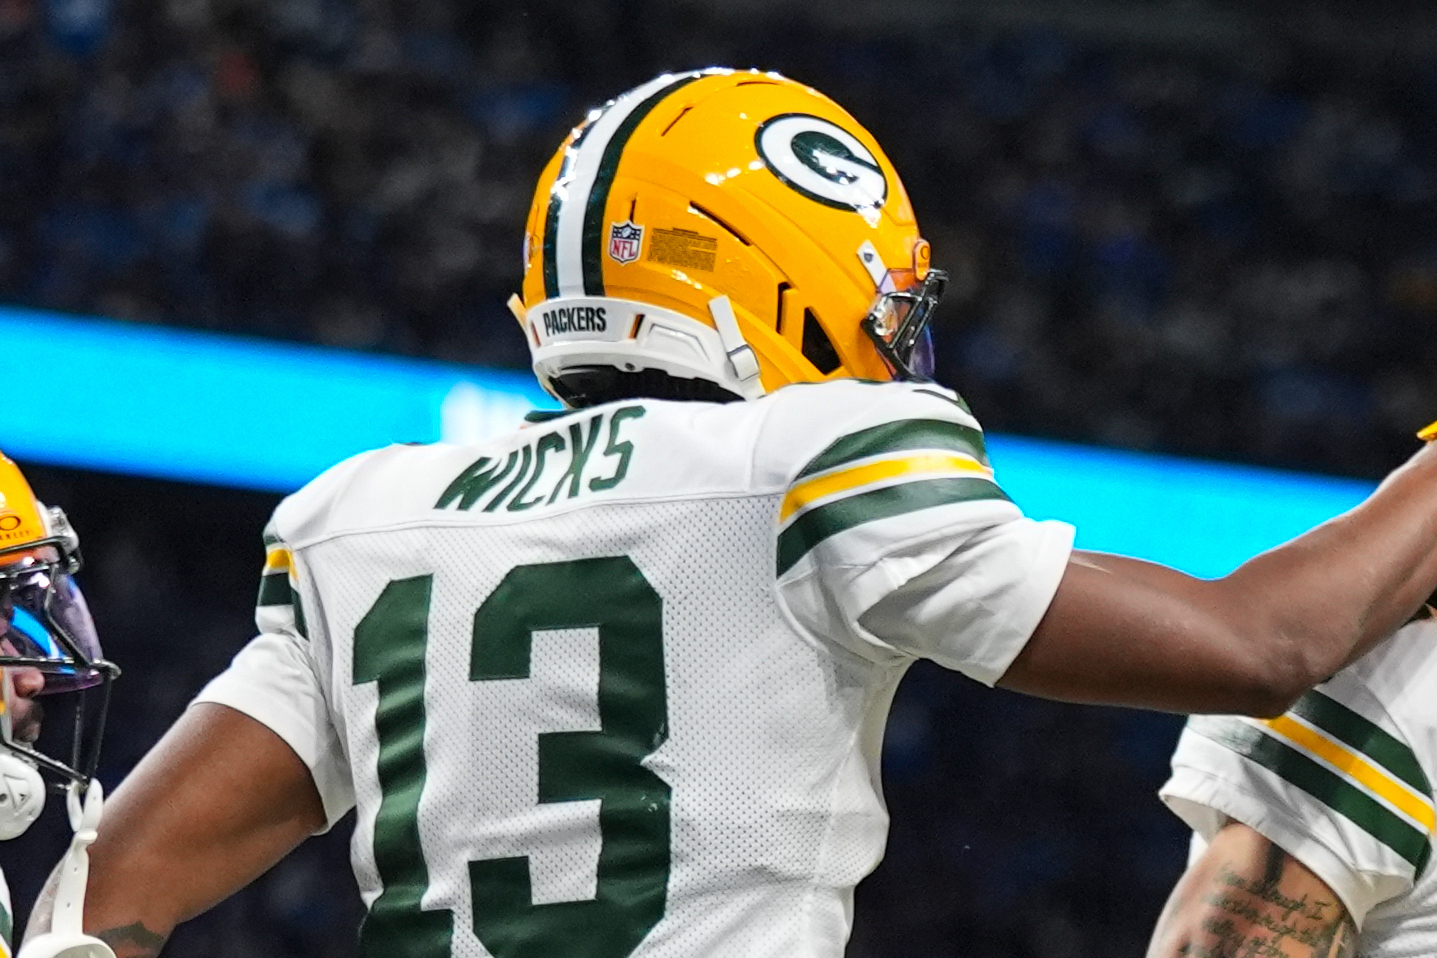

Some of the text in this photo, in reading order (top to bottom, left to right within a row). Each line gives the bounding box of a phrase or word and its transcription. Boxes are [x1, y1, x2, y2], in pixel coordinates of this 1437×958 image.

[611, 239, 637, 259] NFL
[542, 307, 607, 337] PACKERS
[432, 405, 647, 512] WICKS
